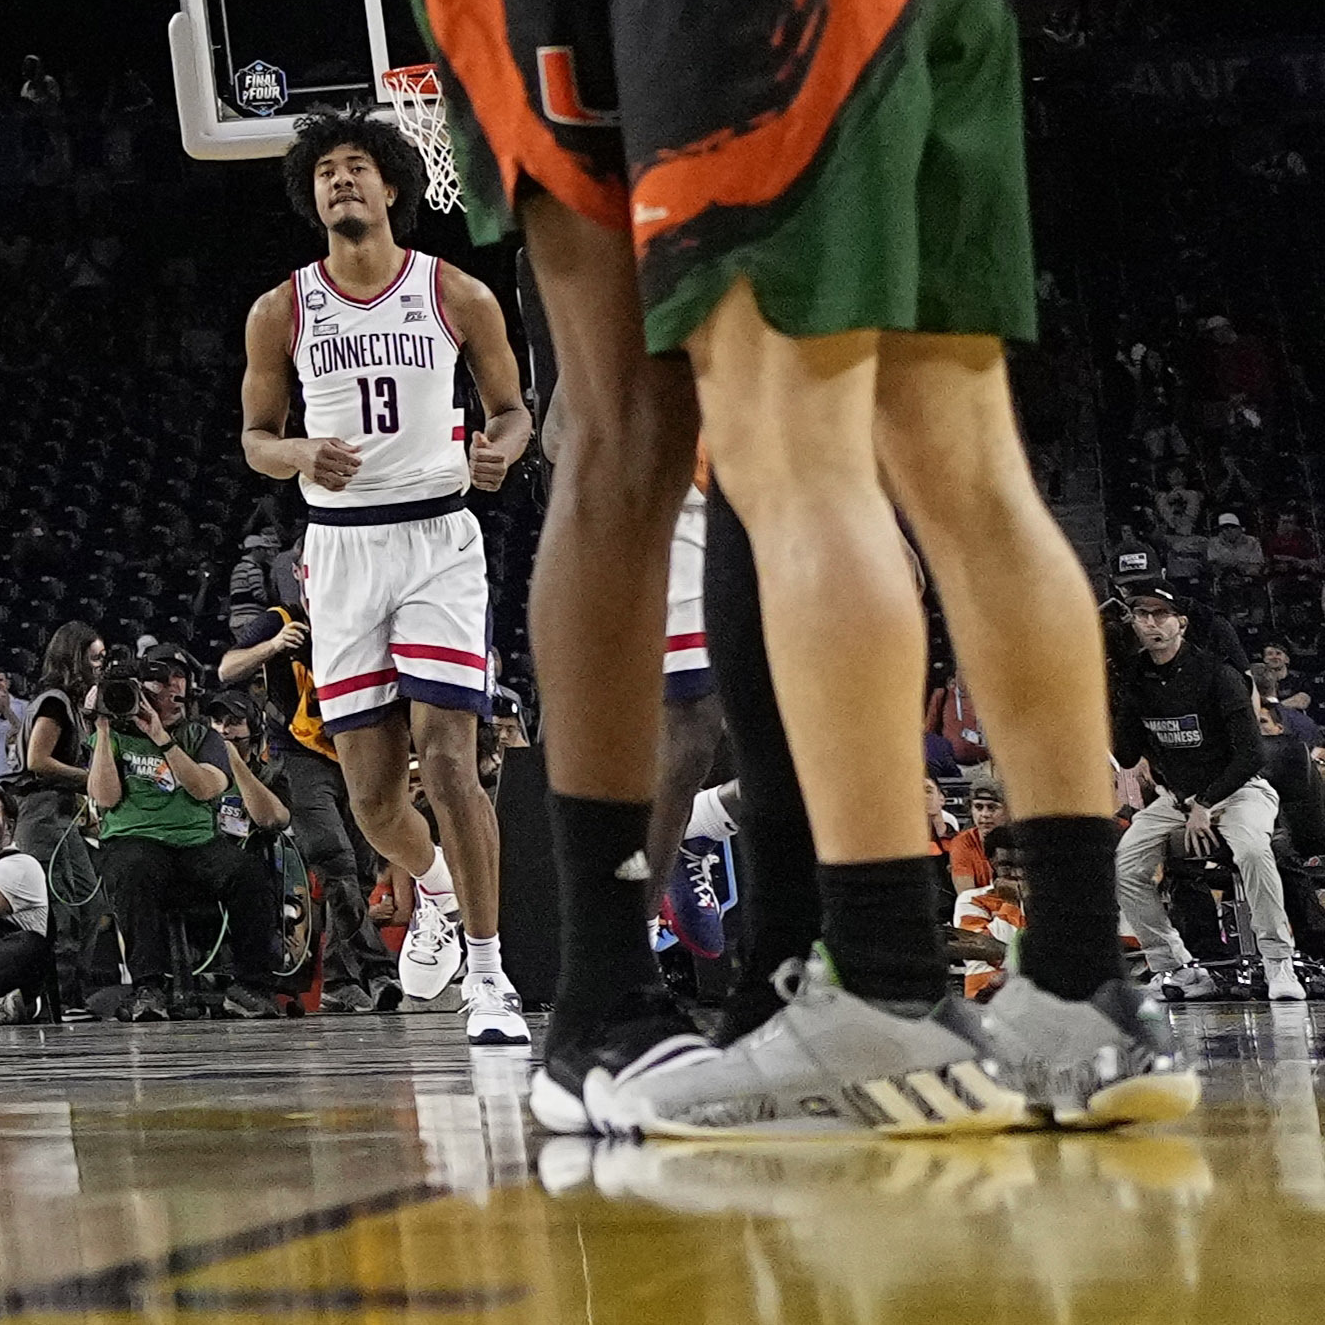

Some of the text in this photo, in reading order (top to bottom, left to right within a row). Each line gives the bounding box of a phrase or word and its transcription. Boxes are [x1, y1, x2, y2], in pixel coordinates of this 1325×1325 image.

[245, 74, 278, 88] FINAL
[249, 86, 281, 101] FOUR
[309, 333, 435, 378] CONNECTICUT
[356, 376, 400, 435] 13
